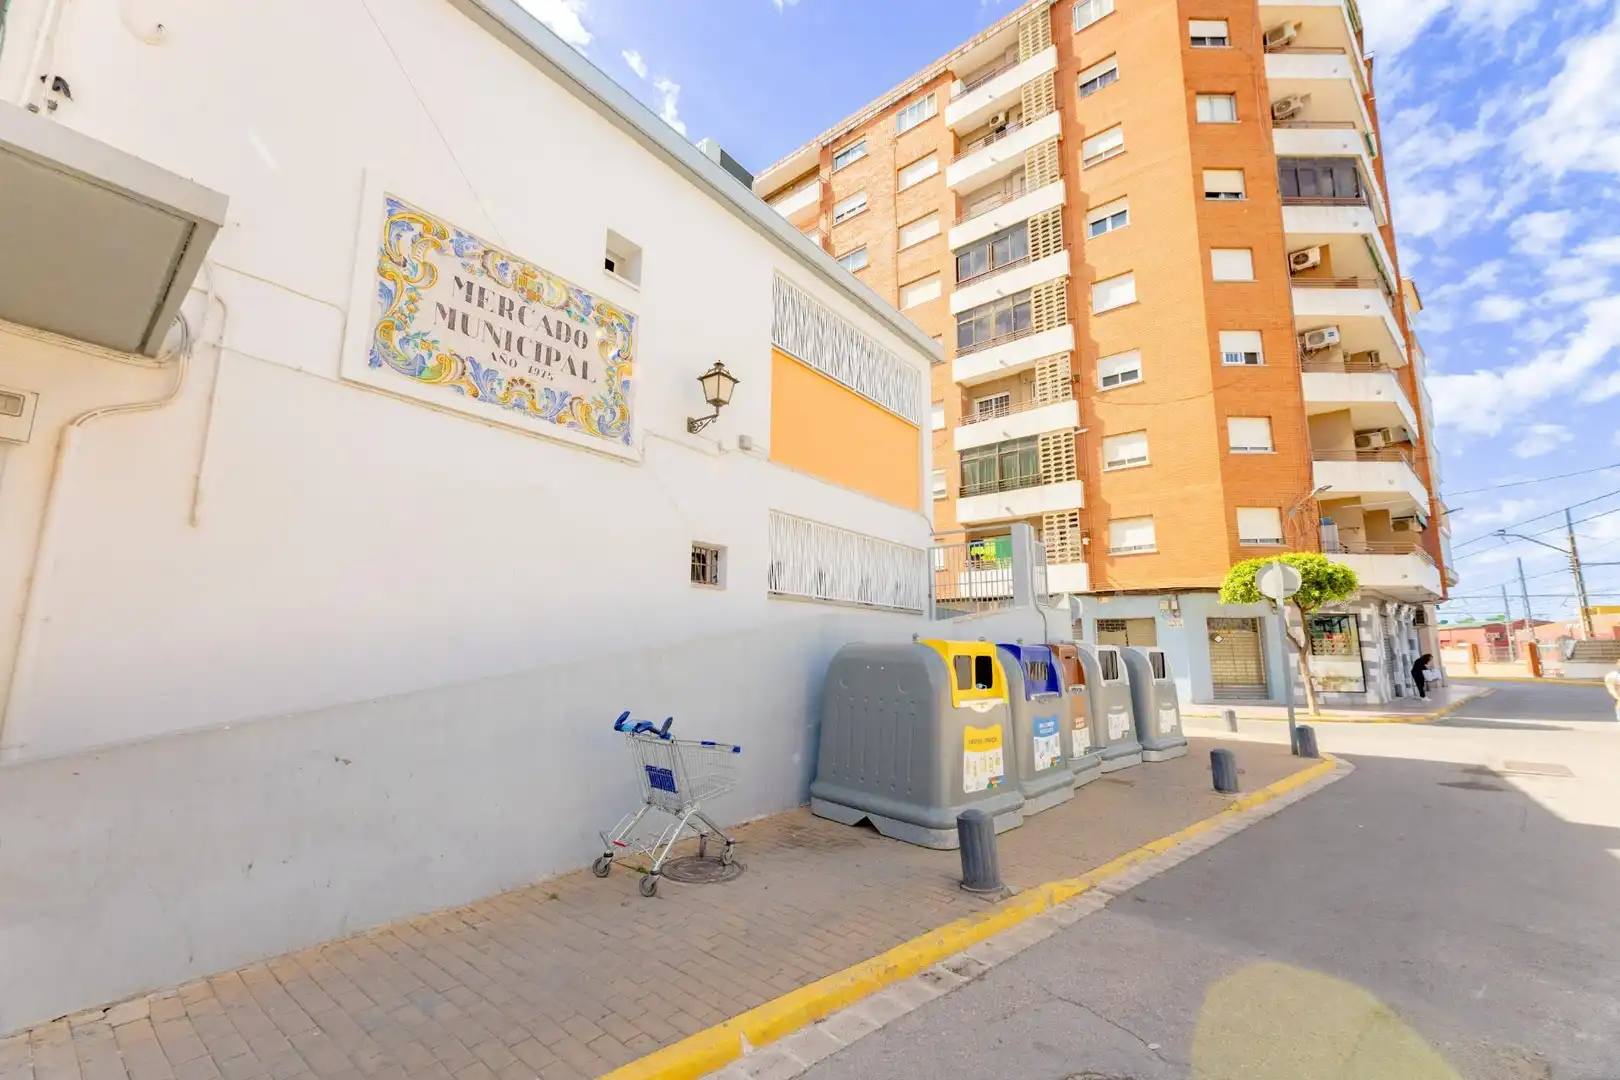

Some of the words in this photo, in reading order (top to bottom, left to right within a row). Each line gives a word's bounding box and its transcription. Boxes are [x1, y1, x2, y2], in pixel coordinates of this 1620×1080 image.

[433, 302, 597, 384] MUNICIPAL
[452, 275, 589, 350] MERCADO
[490, 351, 518, 369] AÑO
[527, 365, 554, 382] 1975
